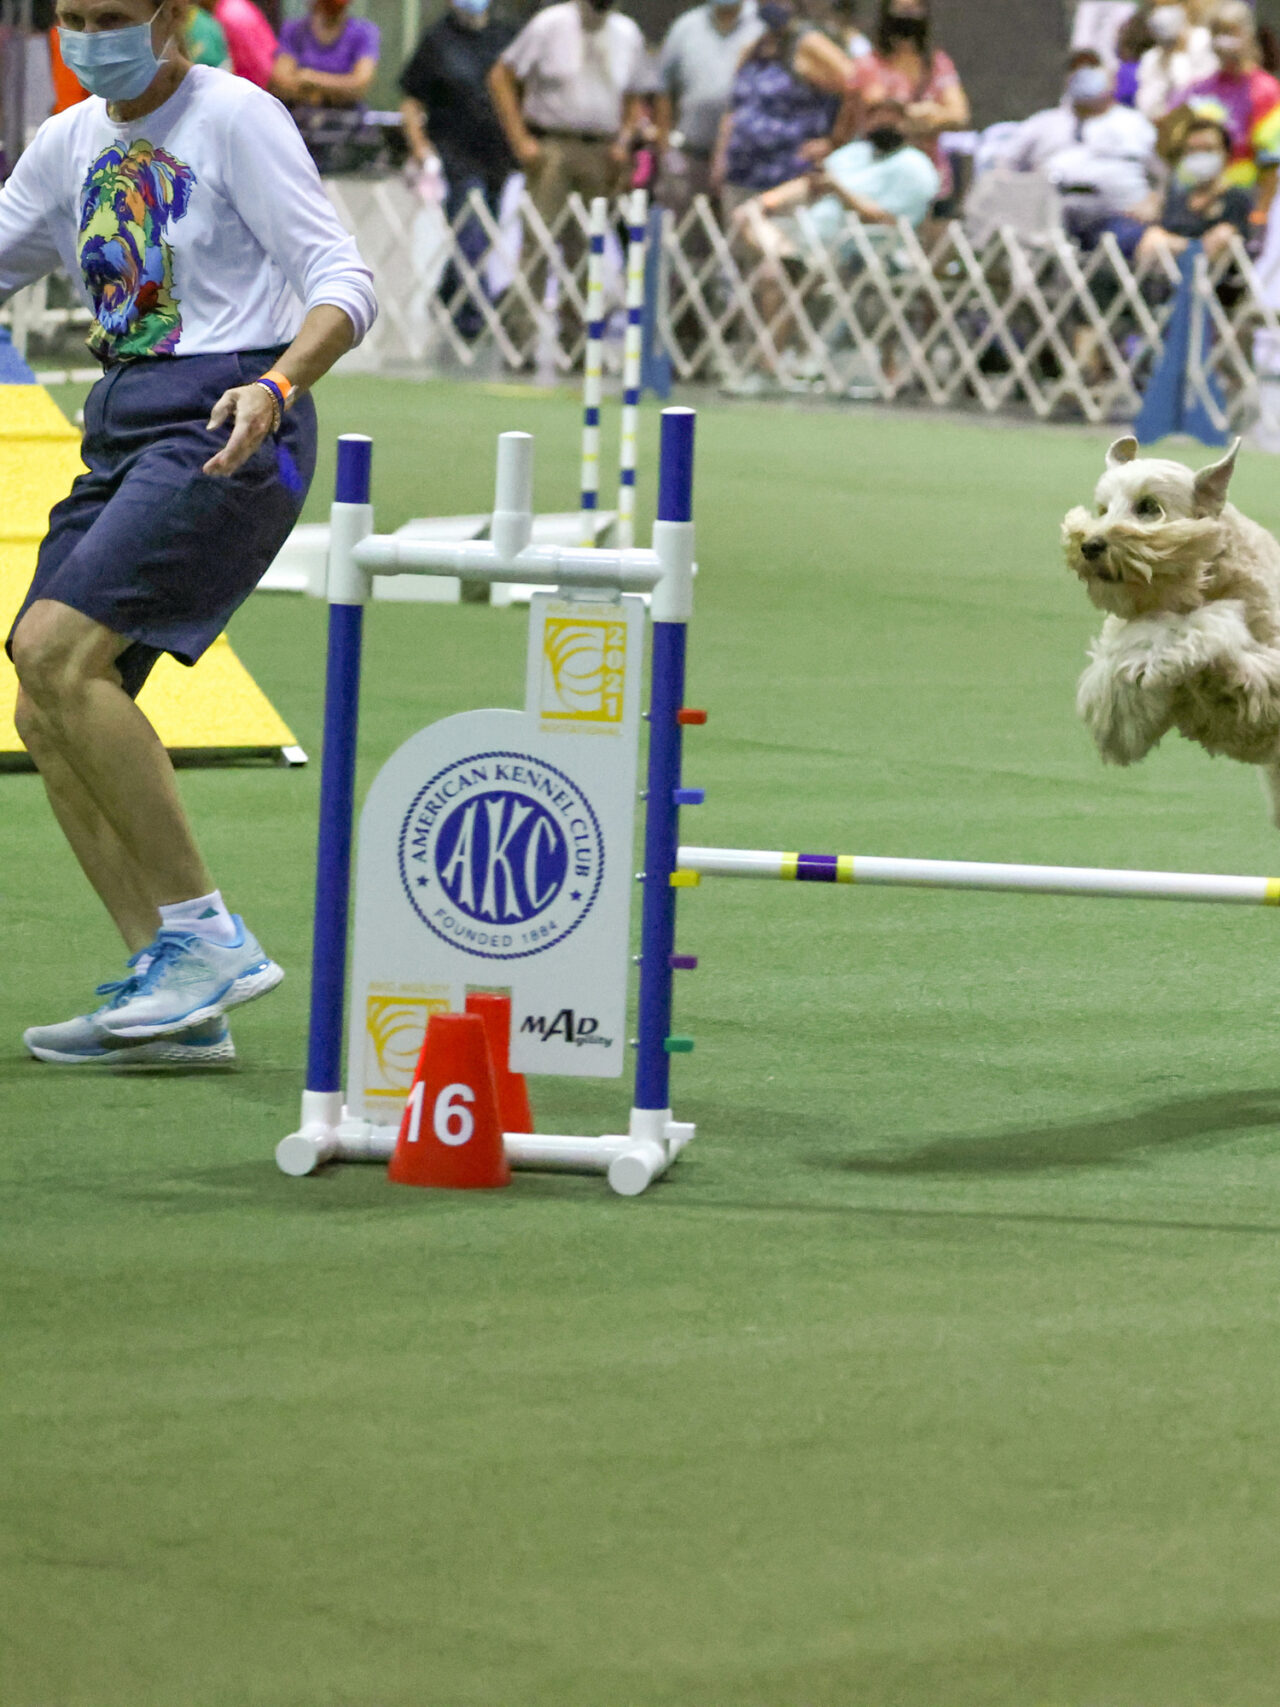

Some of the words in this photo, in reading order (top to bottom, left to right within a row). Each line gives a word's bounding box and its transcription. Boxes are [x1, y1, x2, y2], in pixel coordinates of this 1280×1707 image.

[605, 626, 624, 717] 2021
[411, 766, 488, 863] AMERICAN
[495, 764, 574, 816] KENNEL
[570, 818, 591, 877] CLUB
[441, 797, 558, 921] AKC
[434, 908, 513, 947] FOUNDED
[521, 919, 558, 945] 1884
[520, 1009, 599, 1042] MAD
[407, 1080, 476, 1146] 16
